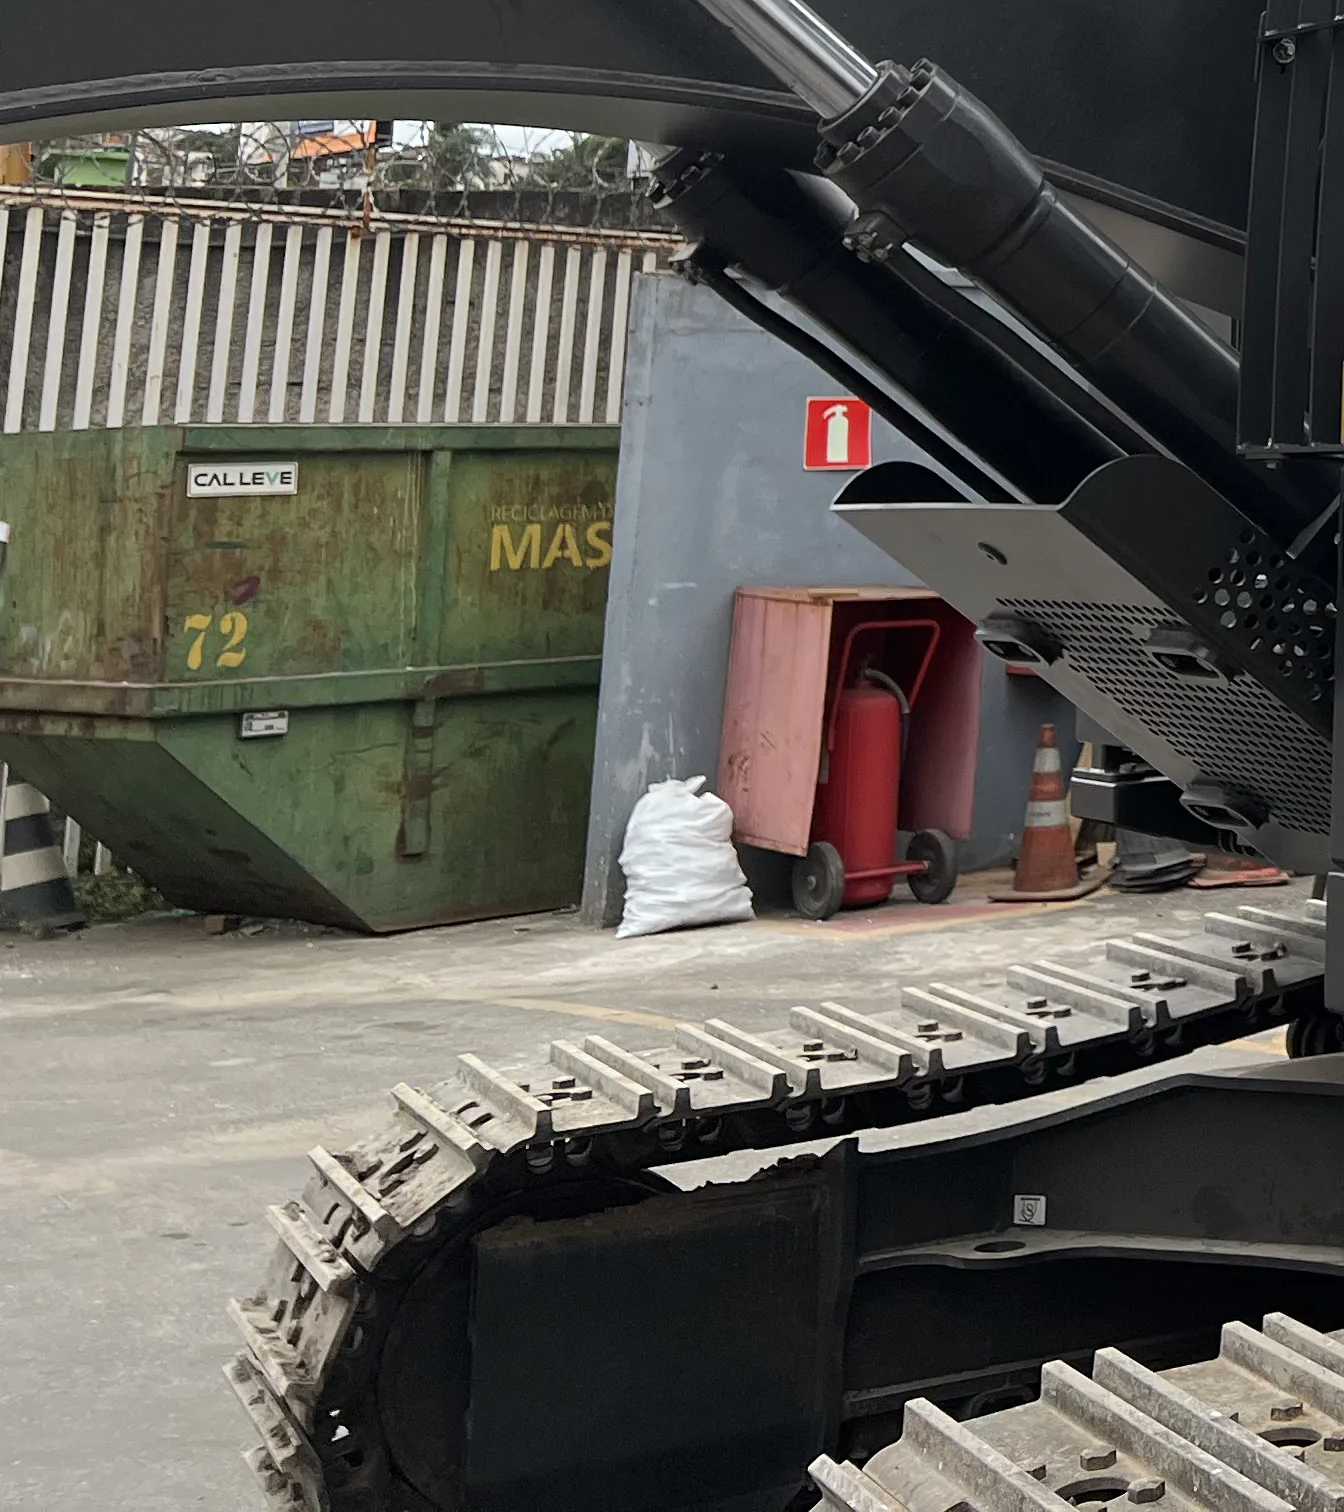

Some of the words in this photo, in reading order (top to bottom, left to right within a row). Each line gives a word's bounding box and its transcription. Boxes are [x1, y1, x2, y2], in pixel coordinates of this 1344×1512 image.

[194, 472, 236, 487] CAL
[239, 471, 293, 486] LEVE
[489, 520, 613, 572] MAS
[183, 611, 249, 671] 72
